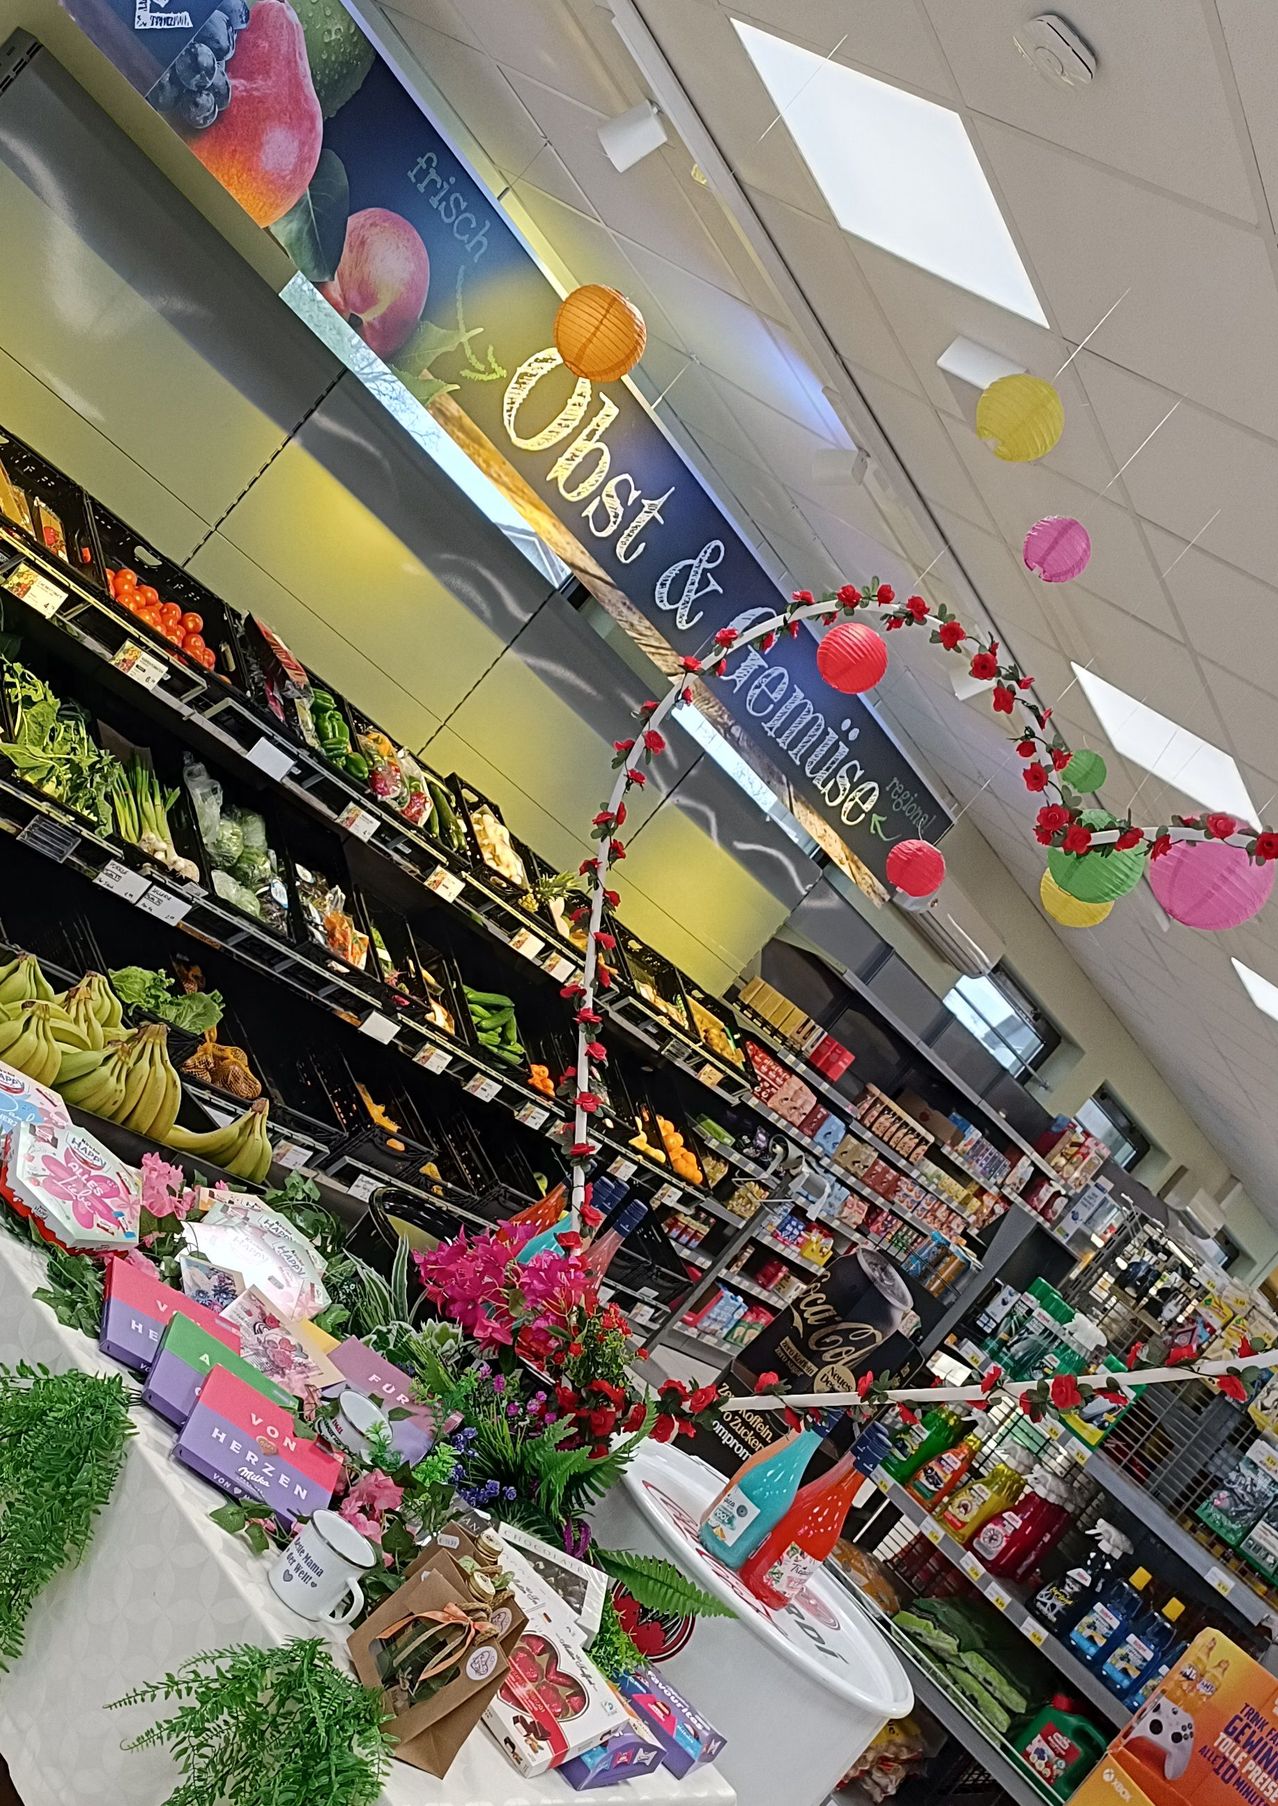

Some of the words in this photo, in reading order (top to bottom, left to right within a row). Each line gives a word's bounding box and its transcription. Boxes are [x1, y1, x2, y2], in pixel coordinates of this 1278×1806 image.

[407, 152, 491, 263] frisch
[502, 346, 676, 565] Obst
[655, 539, 725, 631] &
[719, 606, 880, 827] Gemüse
[885, 776, 937, 834] regional
[0, 1073, 26, 1090] APPY
[71, 1137, 107, 1167] HAPPY
[68, 1162, 104, 1196] ALLES
[277, 1245, 306, 1276] HAPPY
[827, 1366, 853, 1392] Neues
[250, 1412, 297, 1452] VON
[211, 1427, 308, 1500] HERZEN
[238, 1466, 271, 1488] Milka
[213, 1473, 232, 1489] VON
[294, 1562, 313, 1586] Welt!
[302, 1553, 325, 1579] Mama
[1240, 1702, 1269, 1733] TRINK
[1198, 1744, 1219, 1765] ALLE
[1213, 1755, 1239, 1785] 10
[1213, 1731, 1248, 1768] TOLLE
[1241, 1759, 1278, 1804] PREISE
[1111, 1777, 1132, 1803] XBOX
